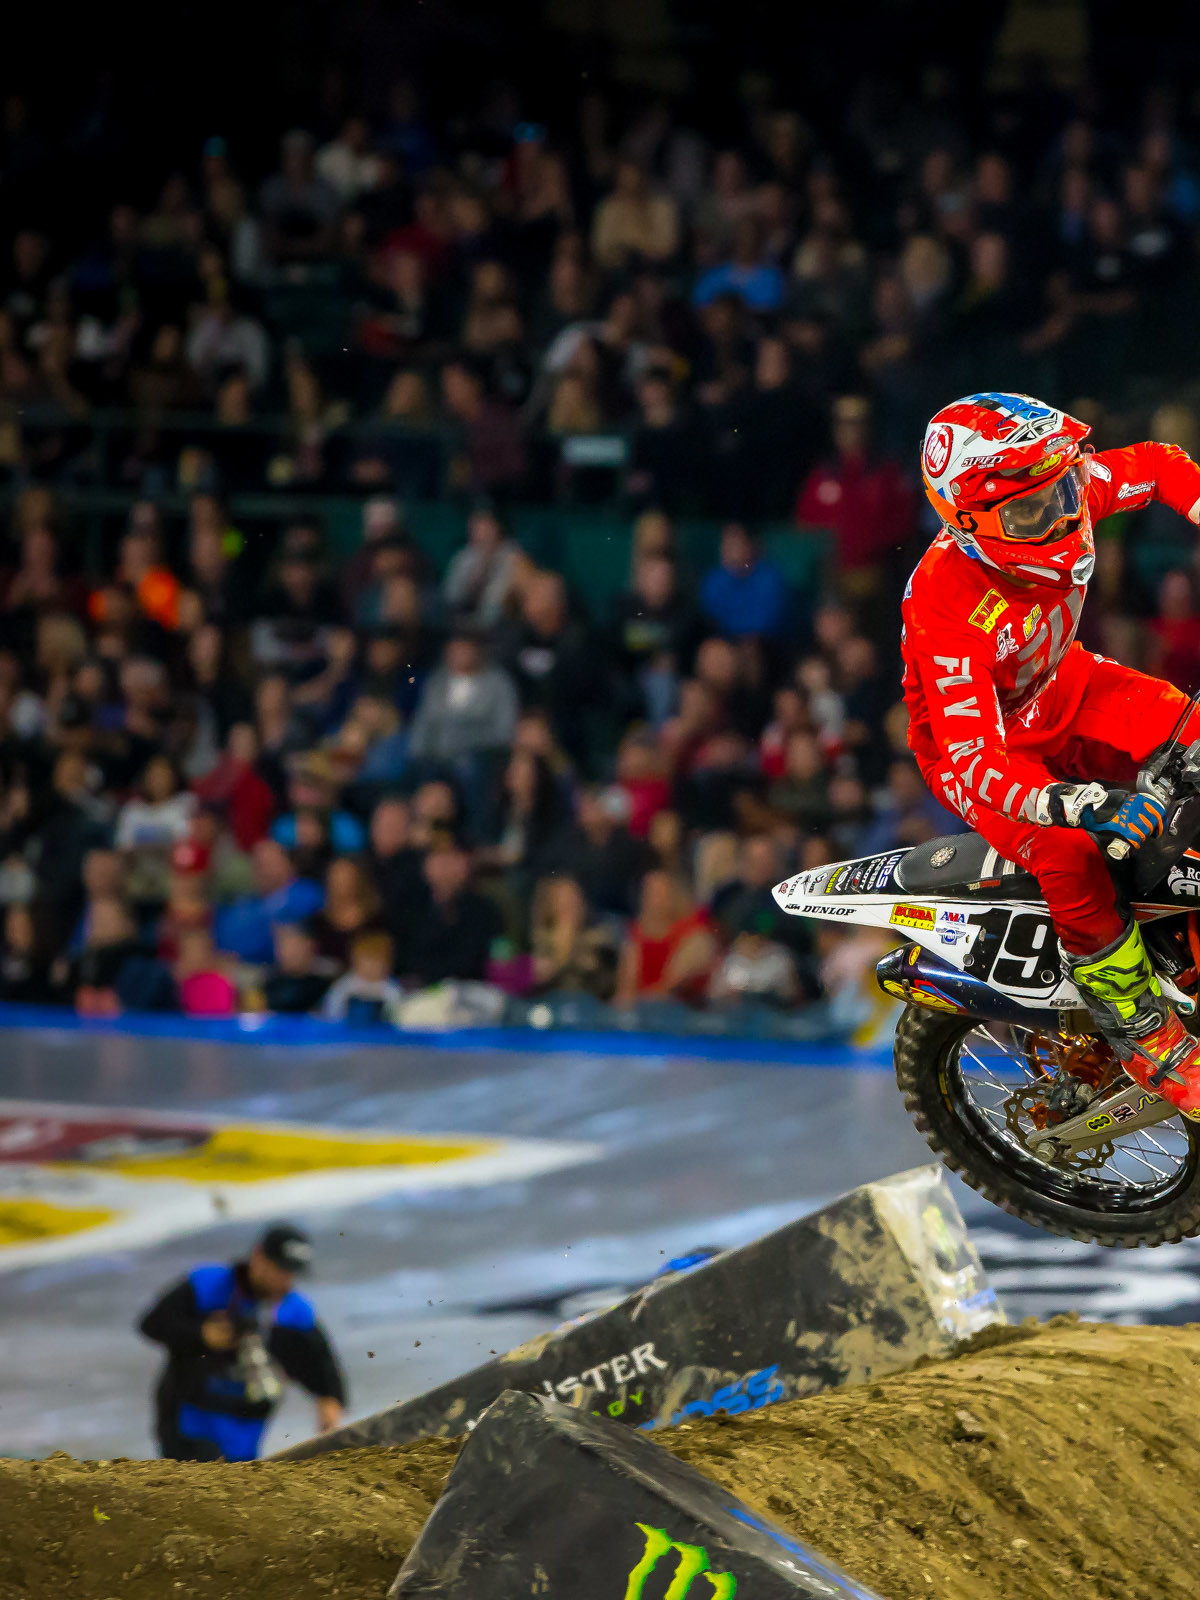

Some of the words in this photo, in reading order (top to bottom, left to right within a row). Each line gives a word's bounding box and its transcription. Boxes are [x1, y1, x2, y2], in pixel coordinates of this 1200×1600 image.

[802, 905, 856, 916] DUNLOP
[894, 905, 933, 922] BUBBA
[940, 911, 966, 924] AMA
[964, 907, 1062, 989] 19
